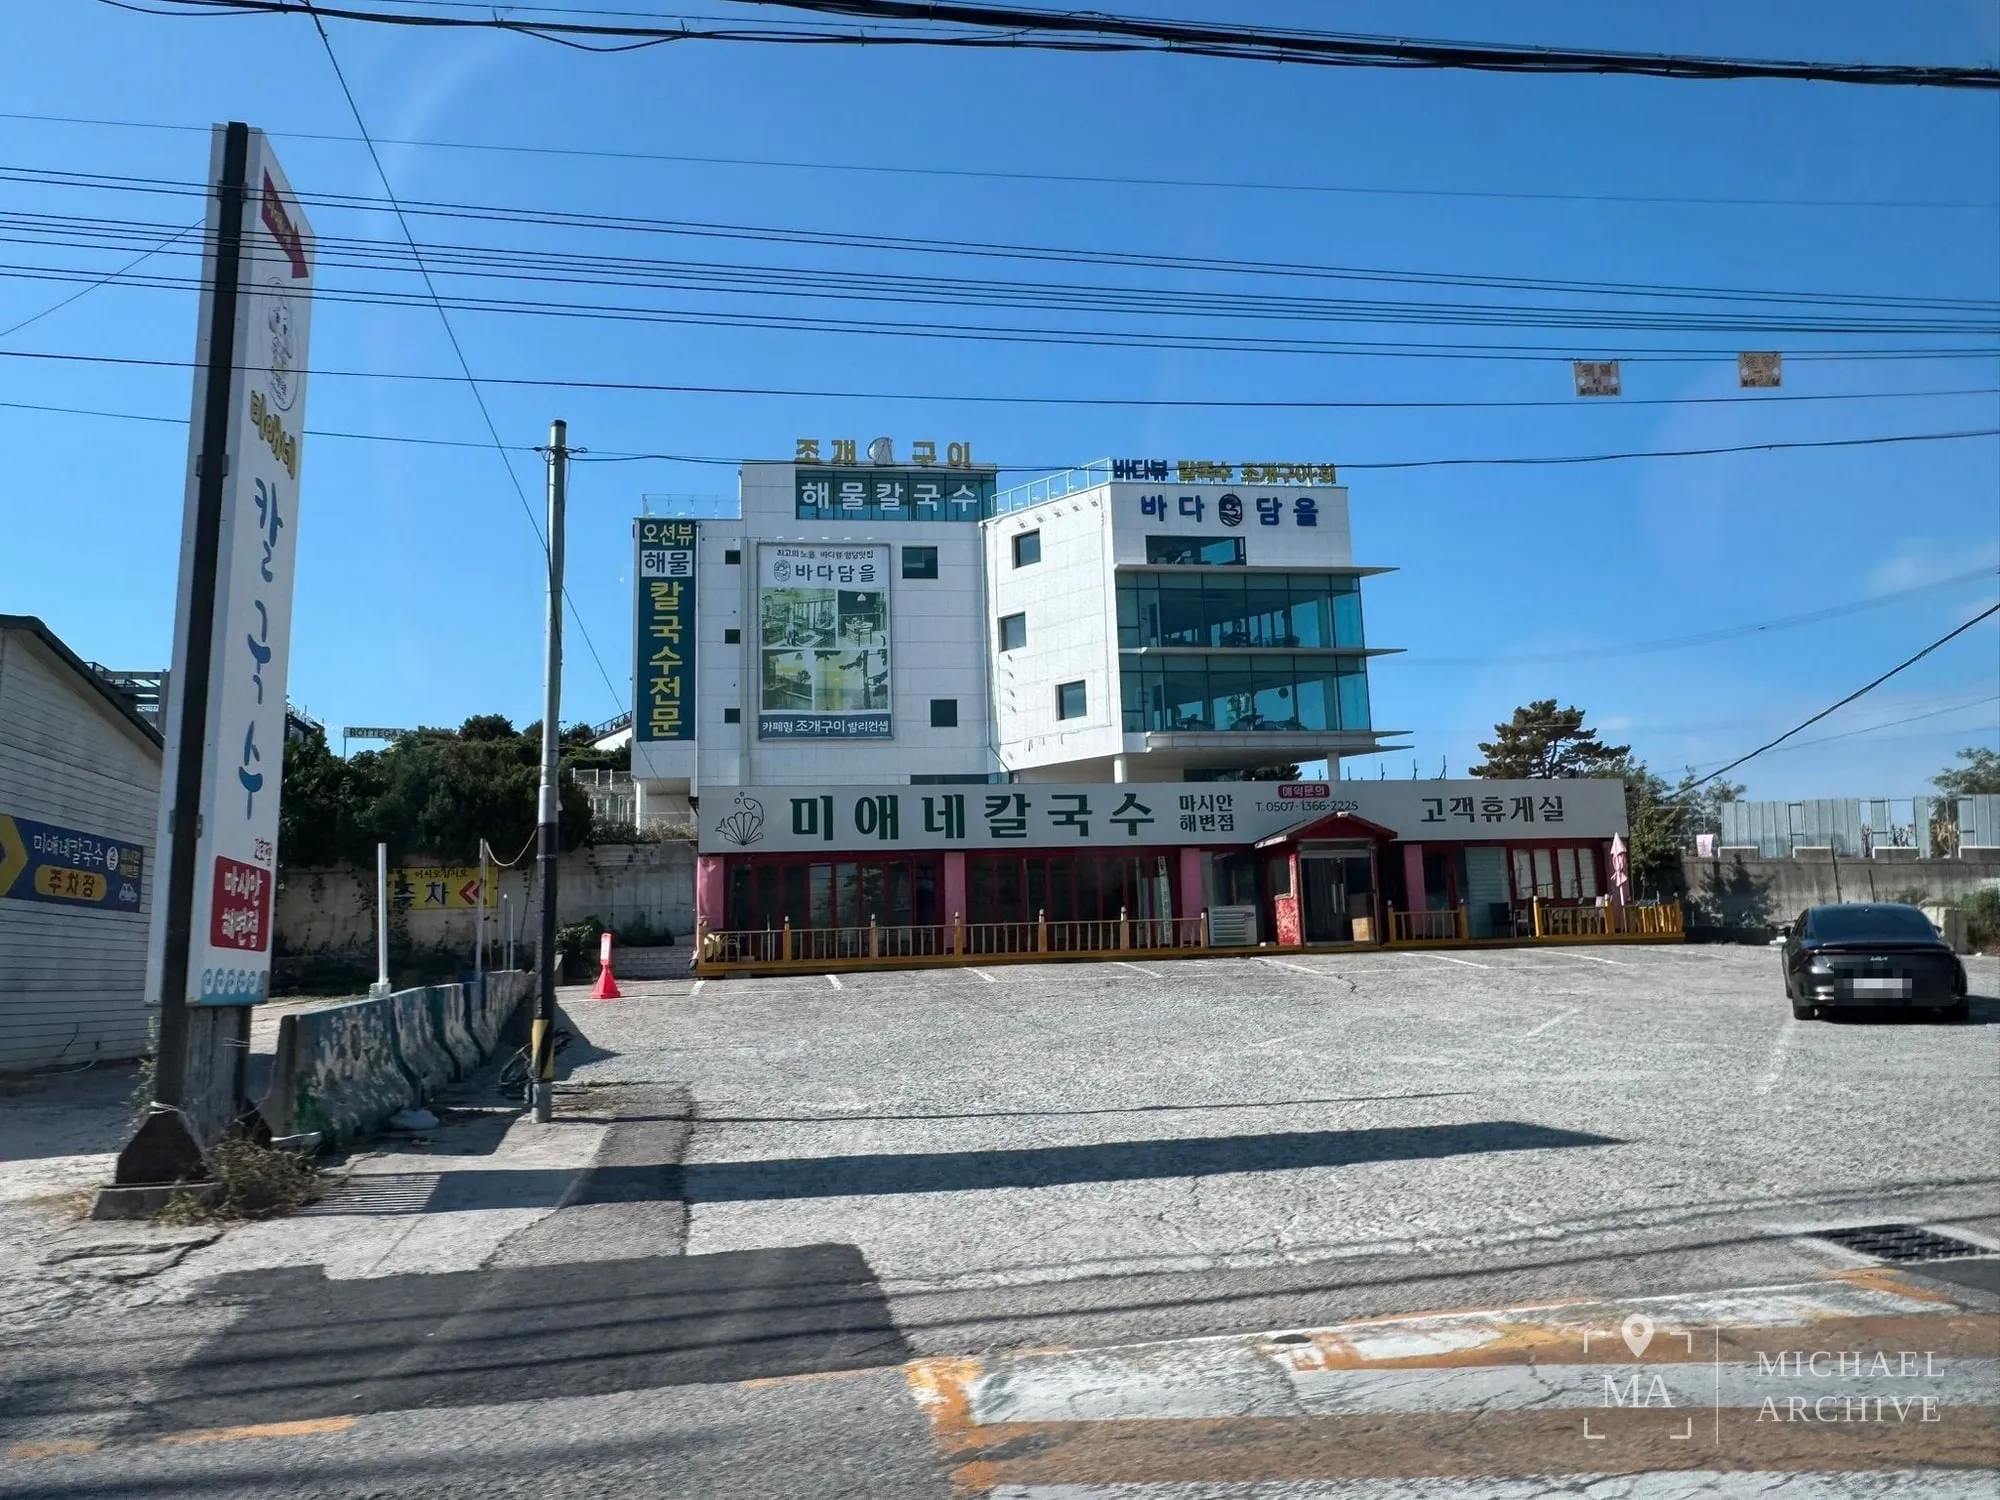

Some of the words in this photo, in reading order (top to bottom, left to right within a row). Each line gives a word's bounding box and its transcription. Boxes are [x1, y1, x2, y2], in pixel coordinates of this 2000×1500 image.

[795, 438, 856, 464] 조개
[912, 441, 972, 467] 구이
[1112, 458, 1169, 481] 바다뷰
[801, 481, 977, 512] 해물칼국수
[1140, 494, 1205, 522] 바다
[642, 523, 694, 546] 오션뷰
[644, 551, 690, 575] 해물
[795, 563, 876, 583] 바다담을
[649, 581, 684, 737] 칼국수전문
[795, 720, 845, 734] 조개구이
[1282, 784, 1325, 797] 예약문의
[1179, 794, 1234, 814] 마시안
[1420, 795, 1565, 824] 고객휴게실
[789, 792, 1155, 841] 미애네칼국수
[1179, 813, 1235, 833] 해변점
[49, 868, 96, 898] 주차장
